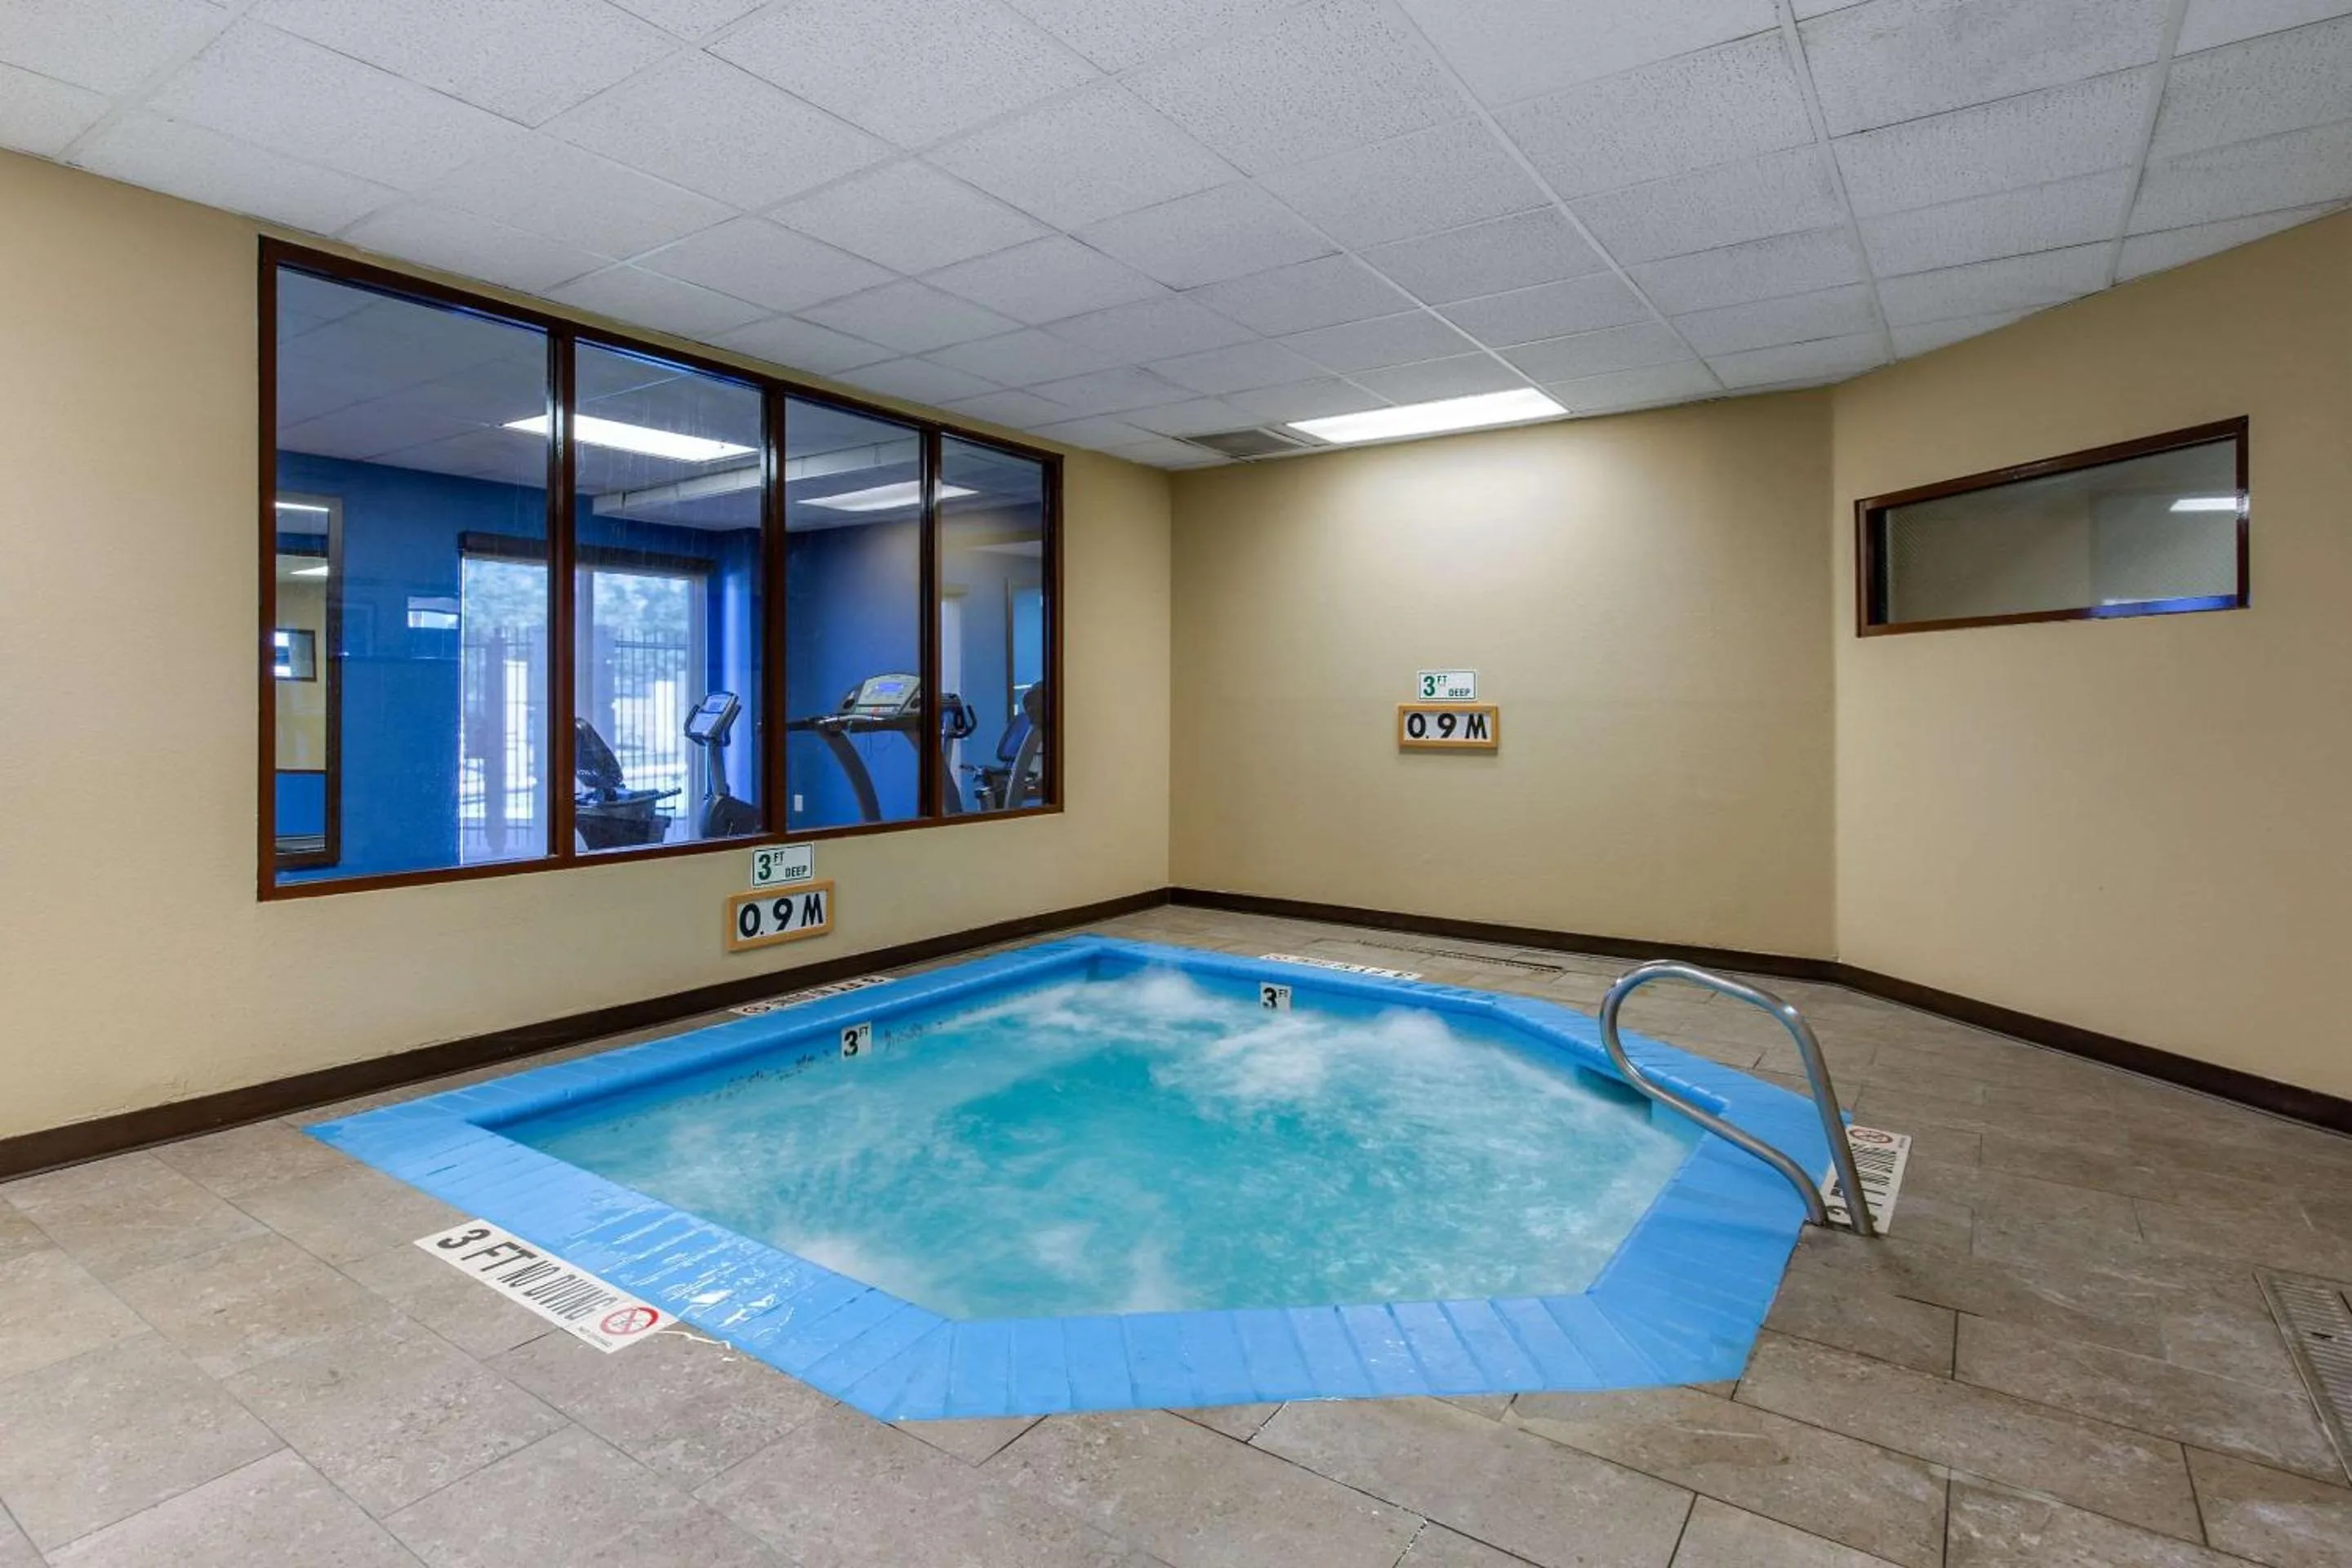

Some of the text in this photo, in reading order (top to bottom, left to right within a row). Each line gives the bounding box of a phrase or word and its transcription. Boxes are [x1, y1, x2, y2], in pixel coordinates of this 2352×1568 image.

[1423, 675, 1447, 697] 3 FT
[1448, 688, 1471, 697] DEEP
[758, 851, 785, 880] 3 FT
[785, 865, 807, 877] DEEP
[1263, 987, 1276, 1009] 3
[844, 1026, 868, 1057] 3 FT
[437, 1228, 491, 1249] 3
[461, 1241, 539, 1272] FT
